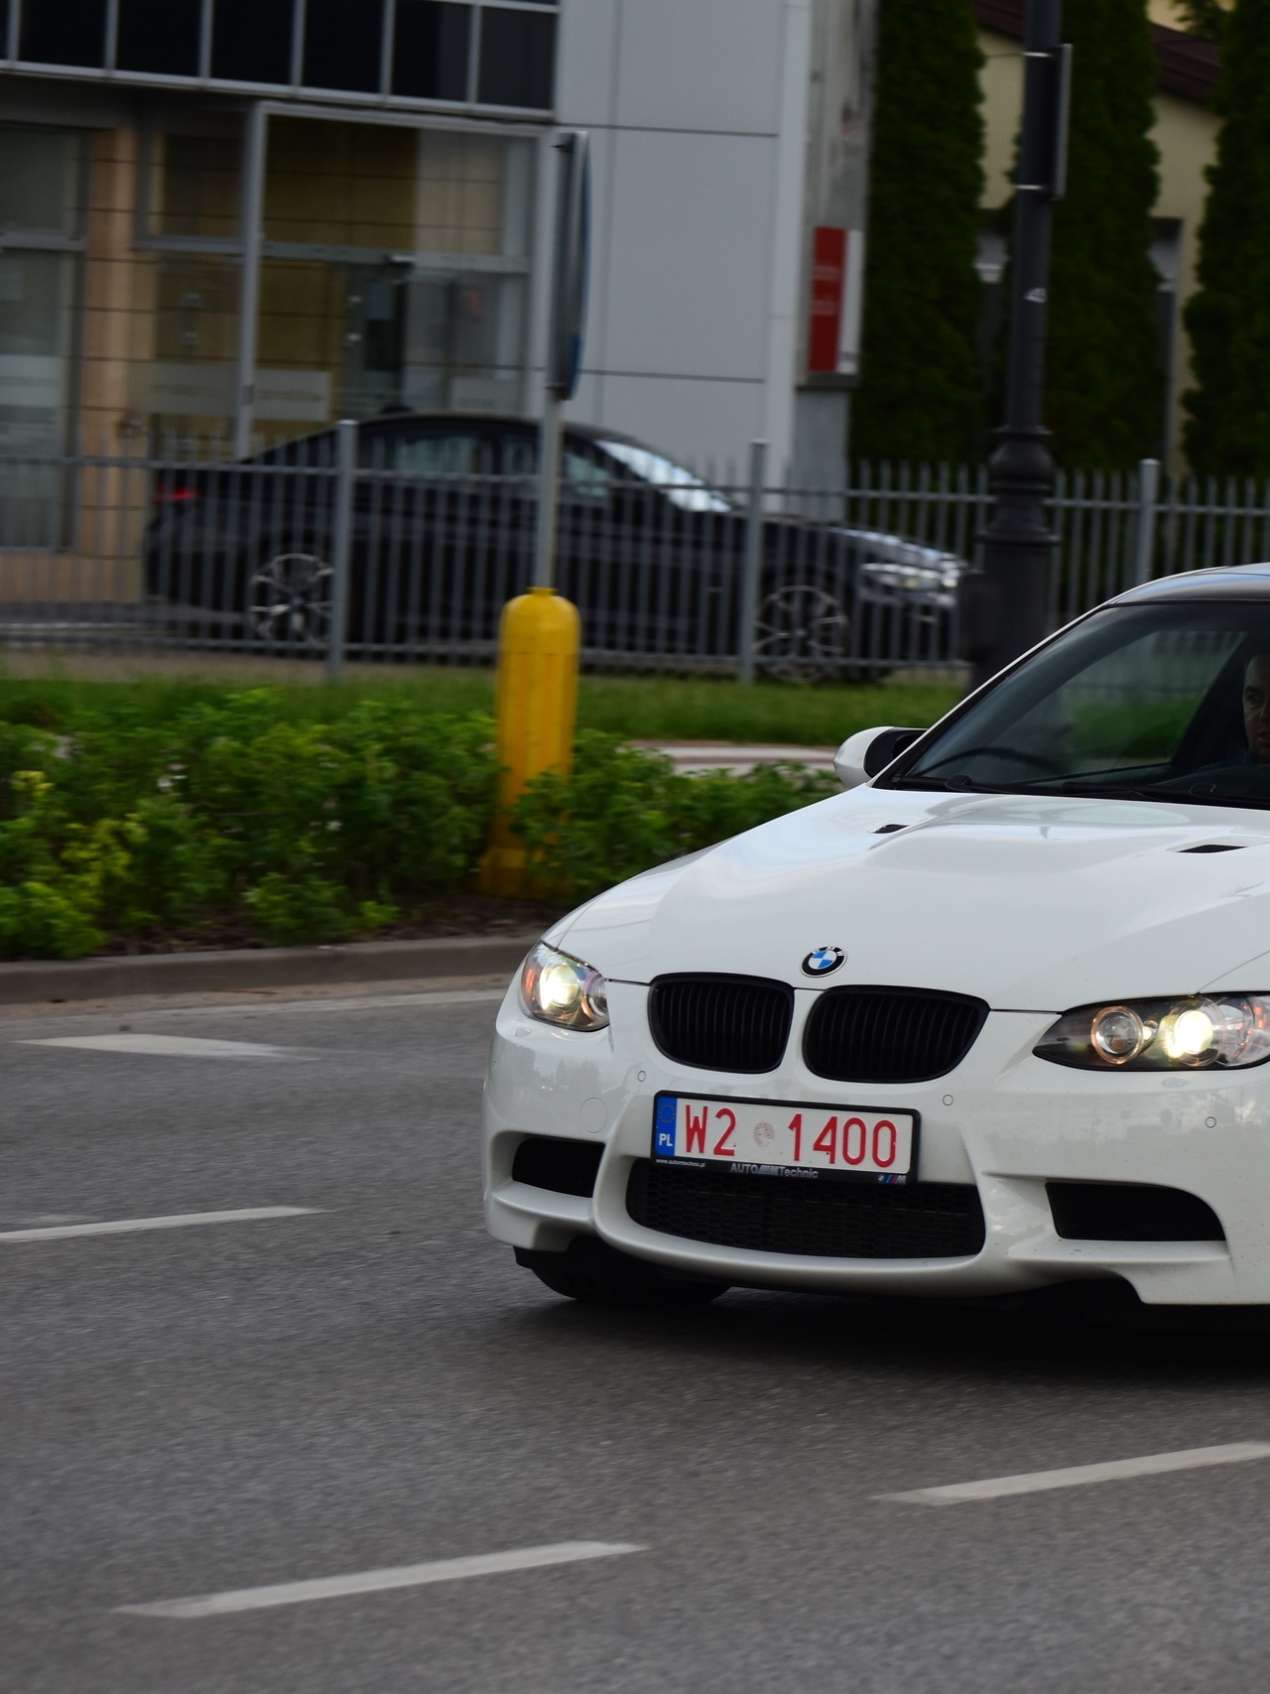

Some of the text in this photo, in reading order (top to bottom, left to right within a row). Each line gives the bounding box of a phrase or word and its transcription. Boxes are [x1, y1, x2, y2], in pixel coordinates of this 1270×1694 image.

[658, 1133, 674, 1147] PL
[685, 1105, 898, 1168] W2 1400
